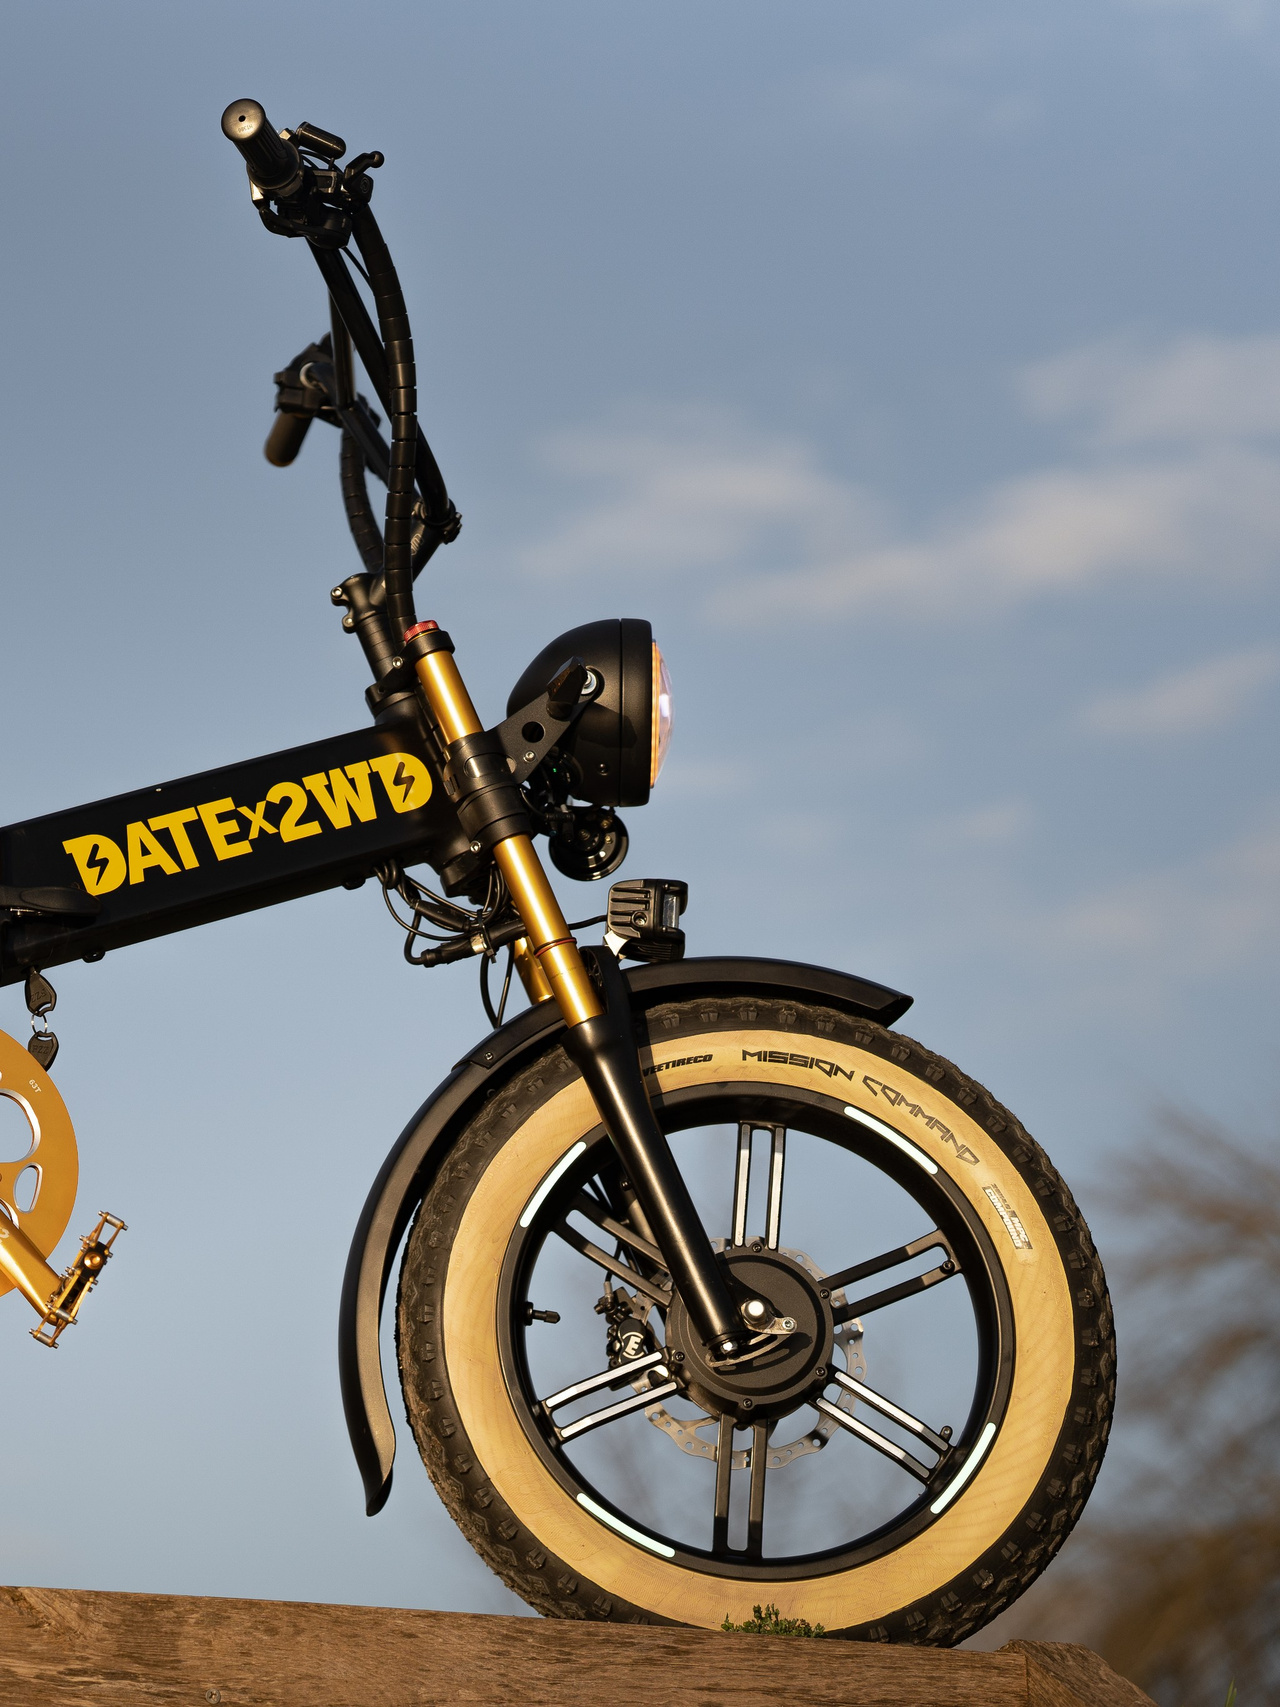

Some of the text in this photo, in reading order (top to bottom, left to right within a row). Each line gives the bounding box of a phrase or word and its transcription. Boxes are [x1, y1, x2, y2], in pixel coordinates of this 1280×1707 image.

[29, 1079, 42, 1093] 63T
[742, 1049, 980, 1165] MISSION COMMAND
